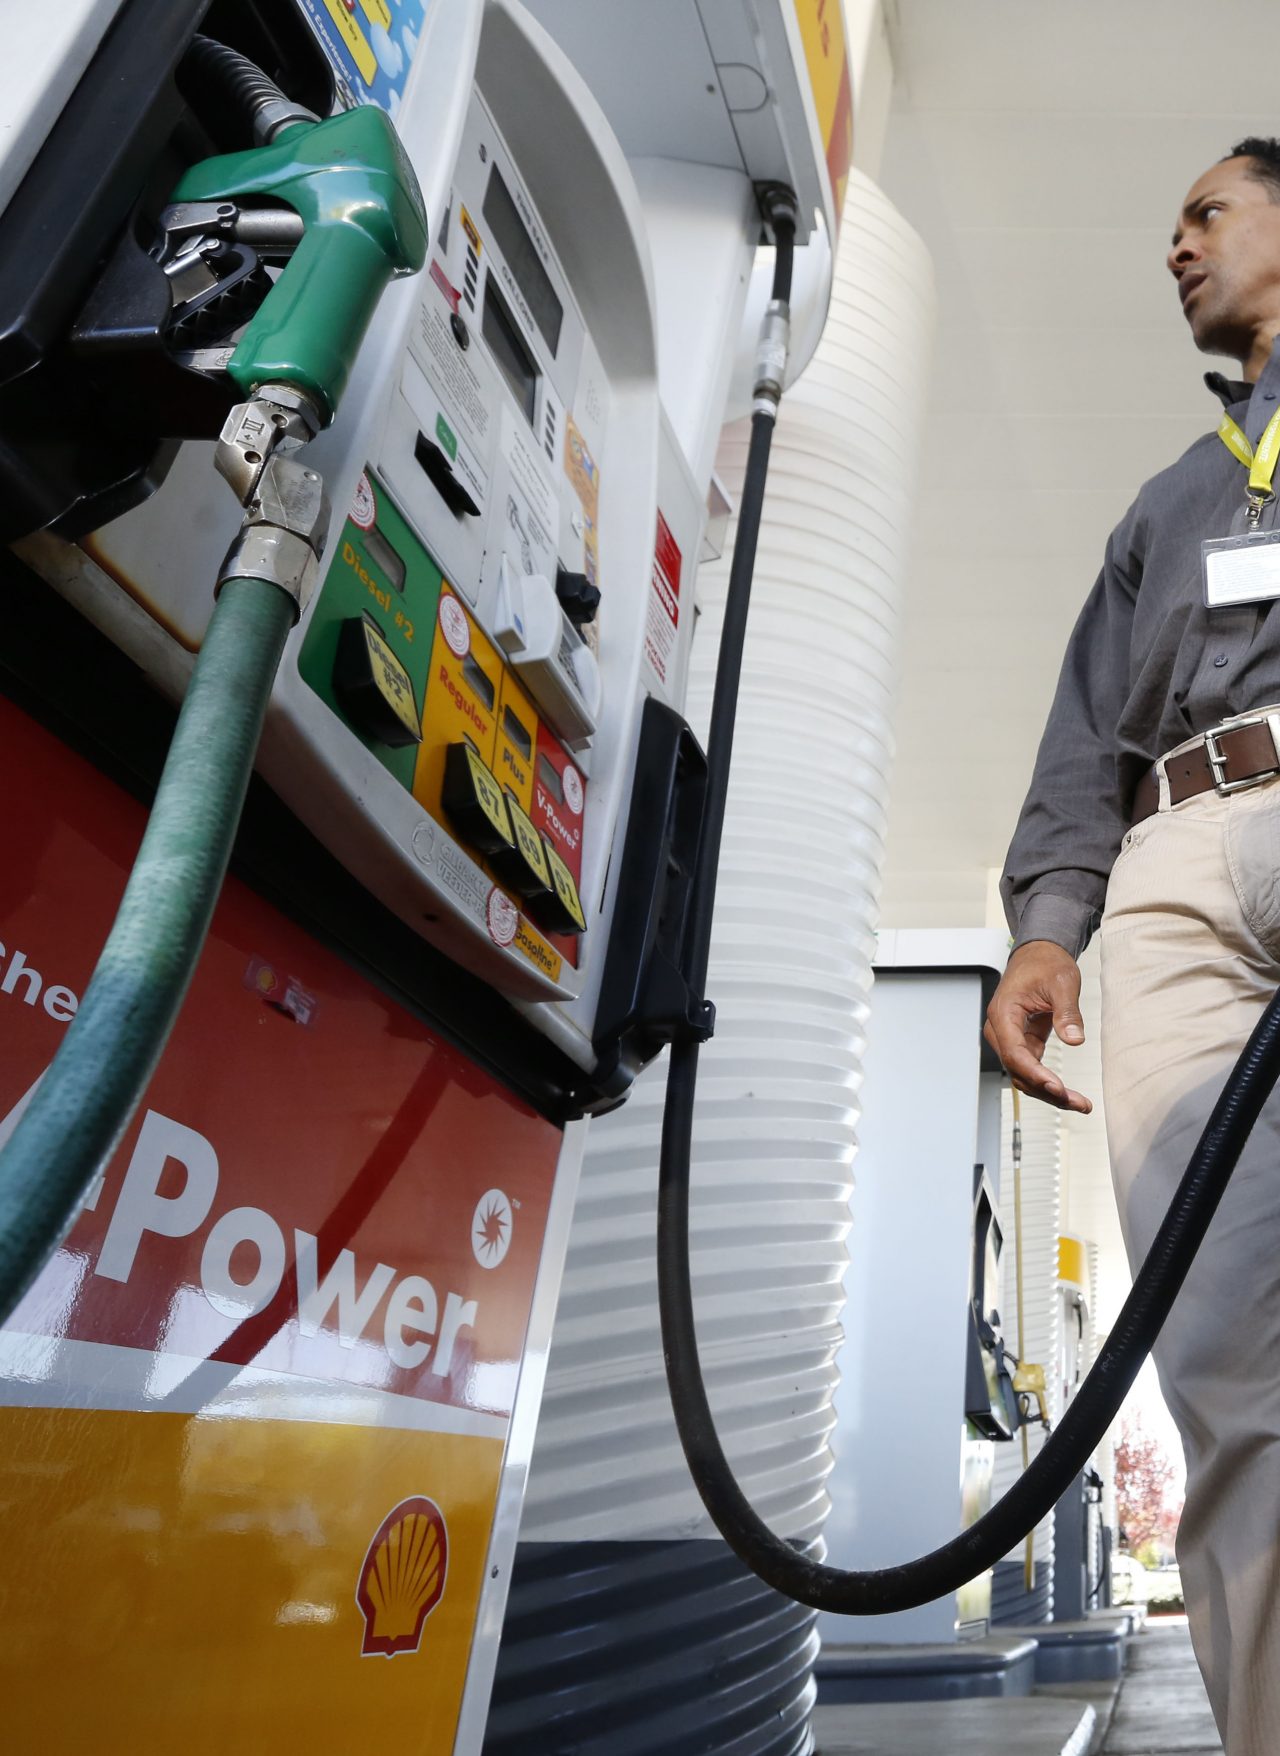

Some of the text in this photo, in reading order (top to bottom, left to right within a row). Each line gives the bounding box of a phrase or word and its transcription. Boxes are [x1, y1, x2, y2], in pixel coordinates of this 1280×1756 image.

[342, 542, 392, 613] Diesel
[394, 609, 415, 645] #2
[439, 664, 488, 735] Regular
[477, 776, 500, 818] 87
[503, 746, 525, 785] Plus
[518, 825, 541, 866] 89
[537, 788, 577, 849] V-Power
[0, 941, 79, 1022] he
[82, 1108, 478, 1379] -Power
